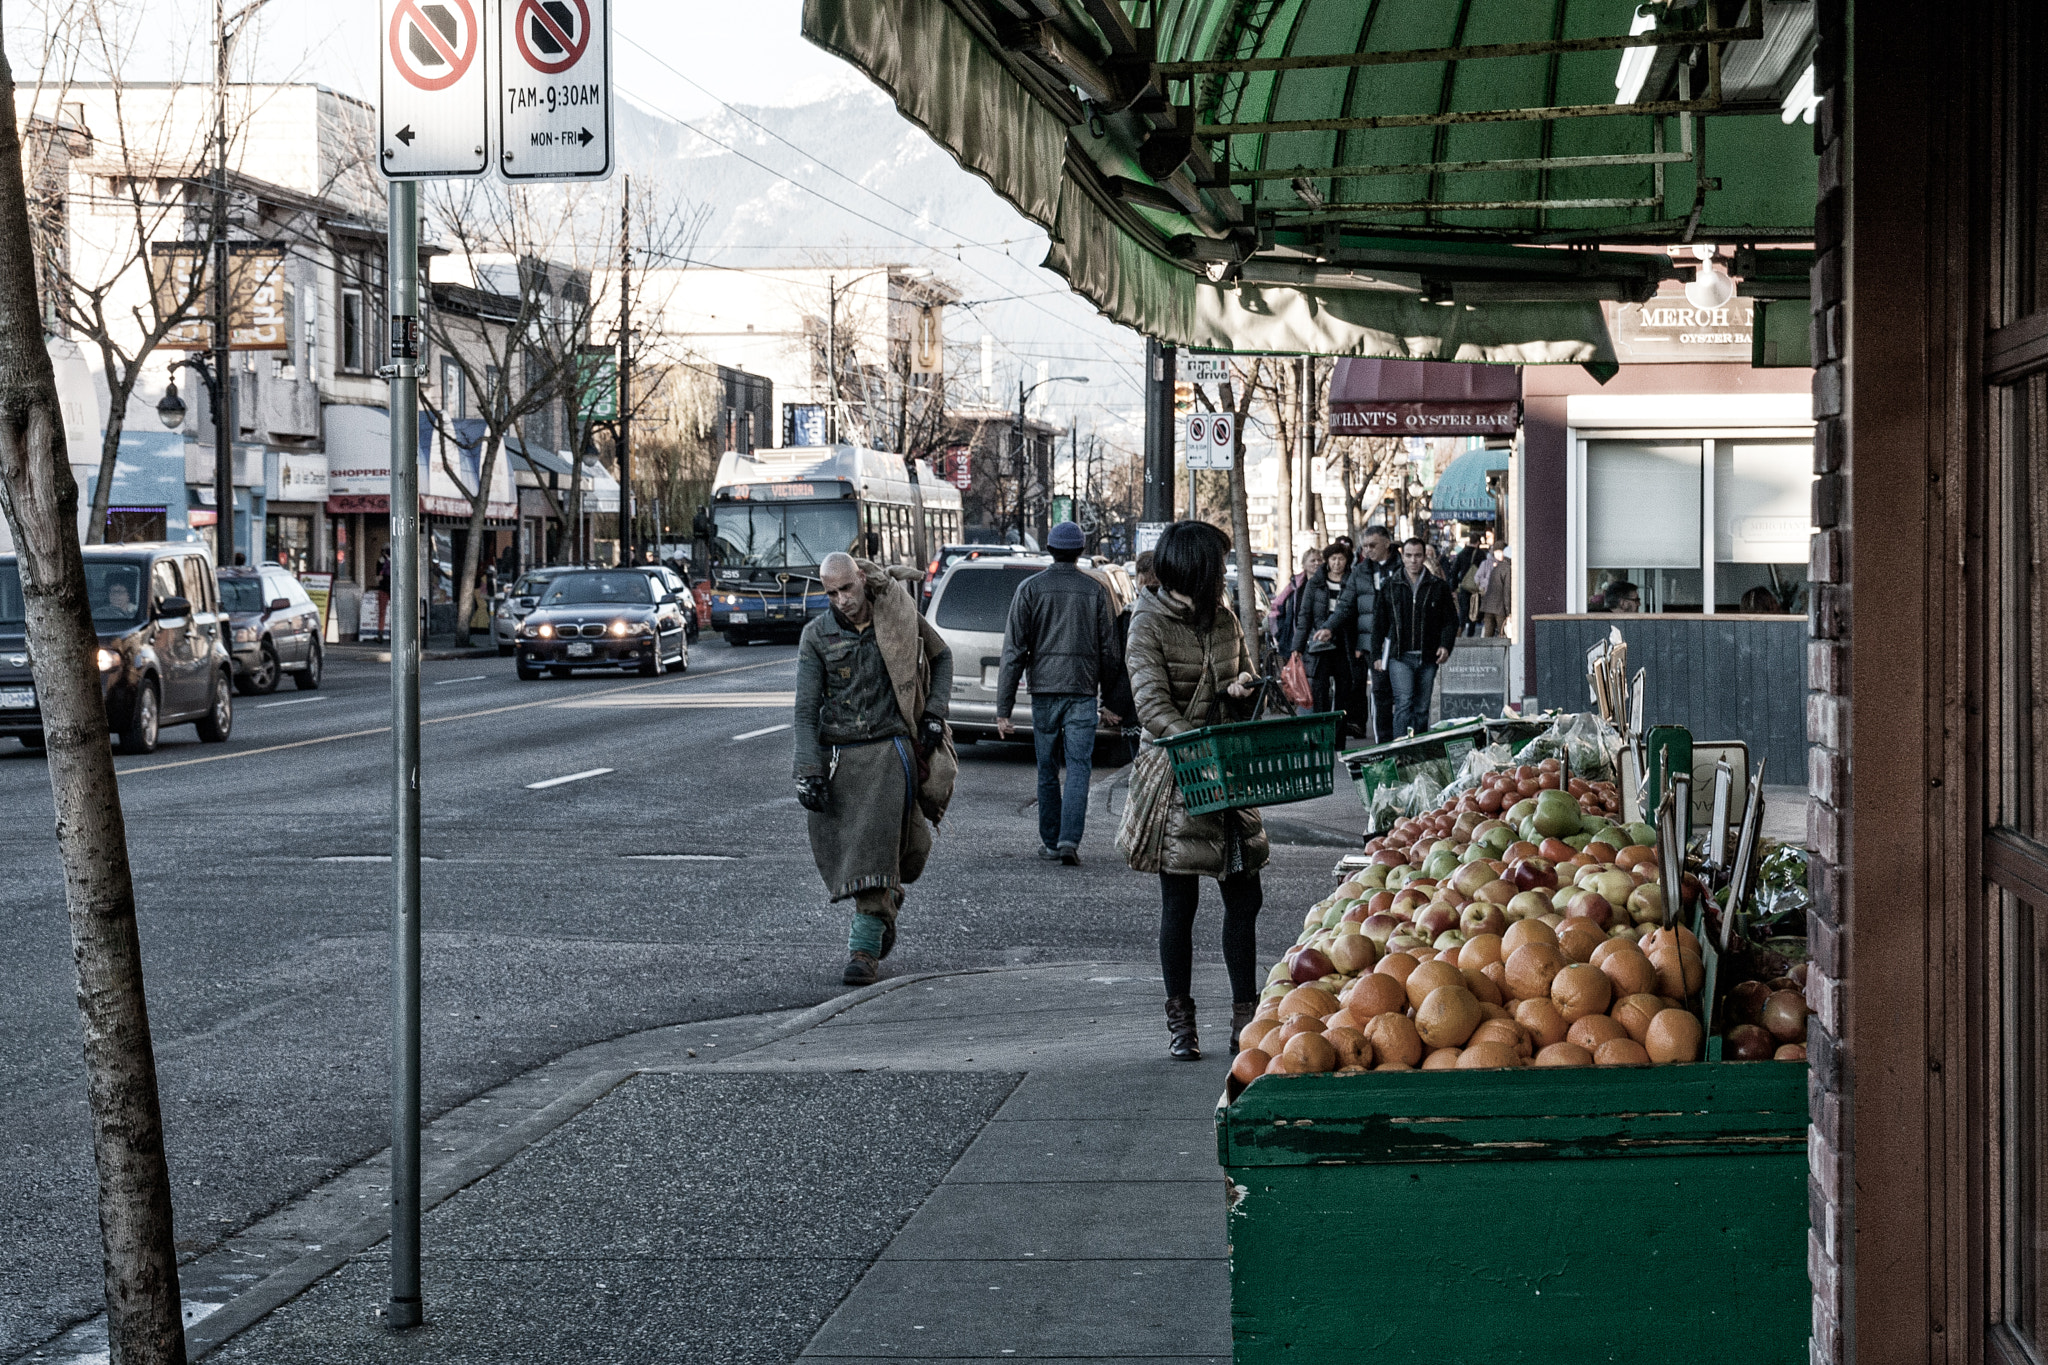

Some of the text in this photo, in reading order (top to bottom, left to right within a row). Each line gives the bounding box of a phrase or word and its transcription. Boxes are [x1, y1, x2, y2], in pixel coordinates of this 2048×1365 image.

[1680, 333, 1732, 344] OYSTER
[1196, 370, 1228, 380] drive
[1405, 414, 1472, 426] OYSTER
[1475, 414, 1509, 426] BAR
[734, 484, 815, 500] 20 VICTORIA
[722, 570, 740, 579] 2515
